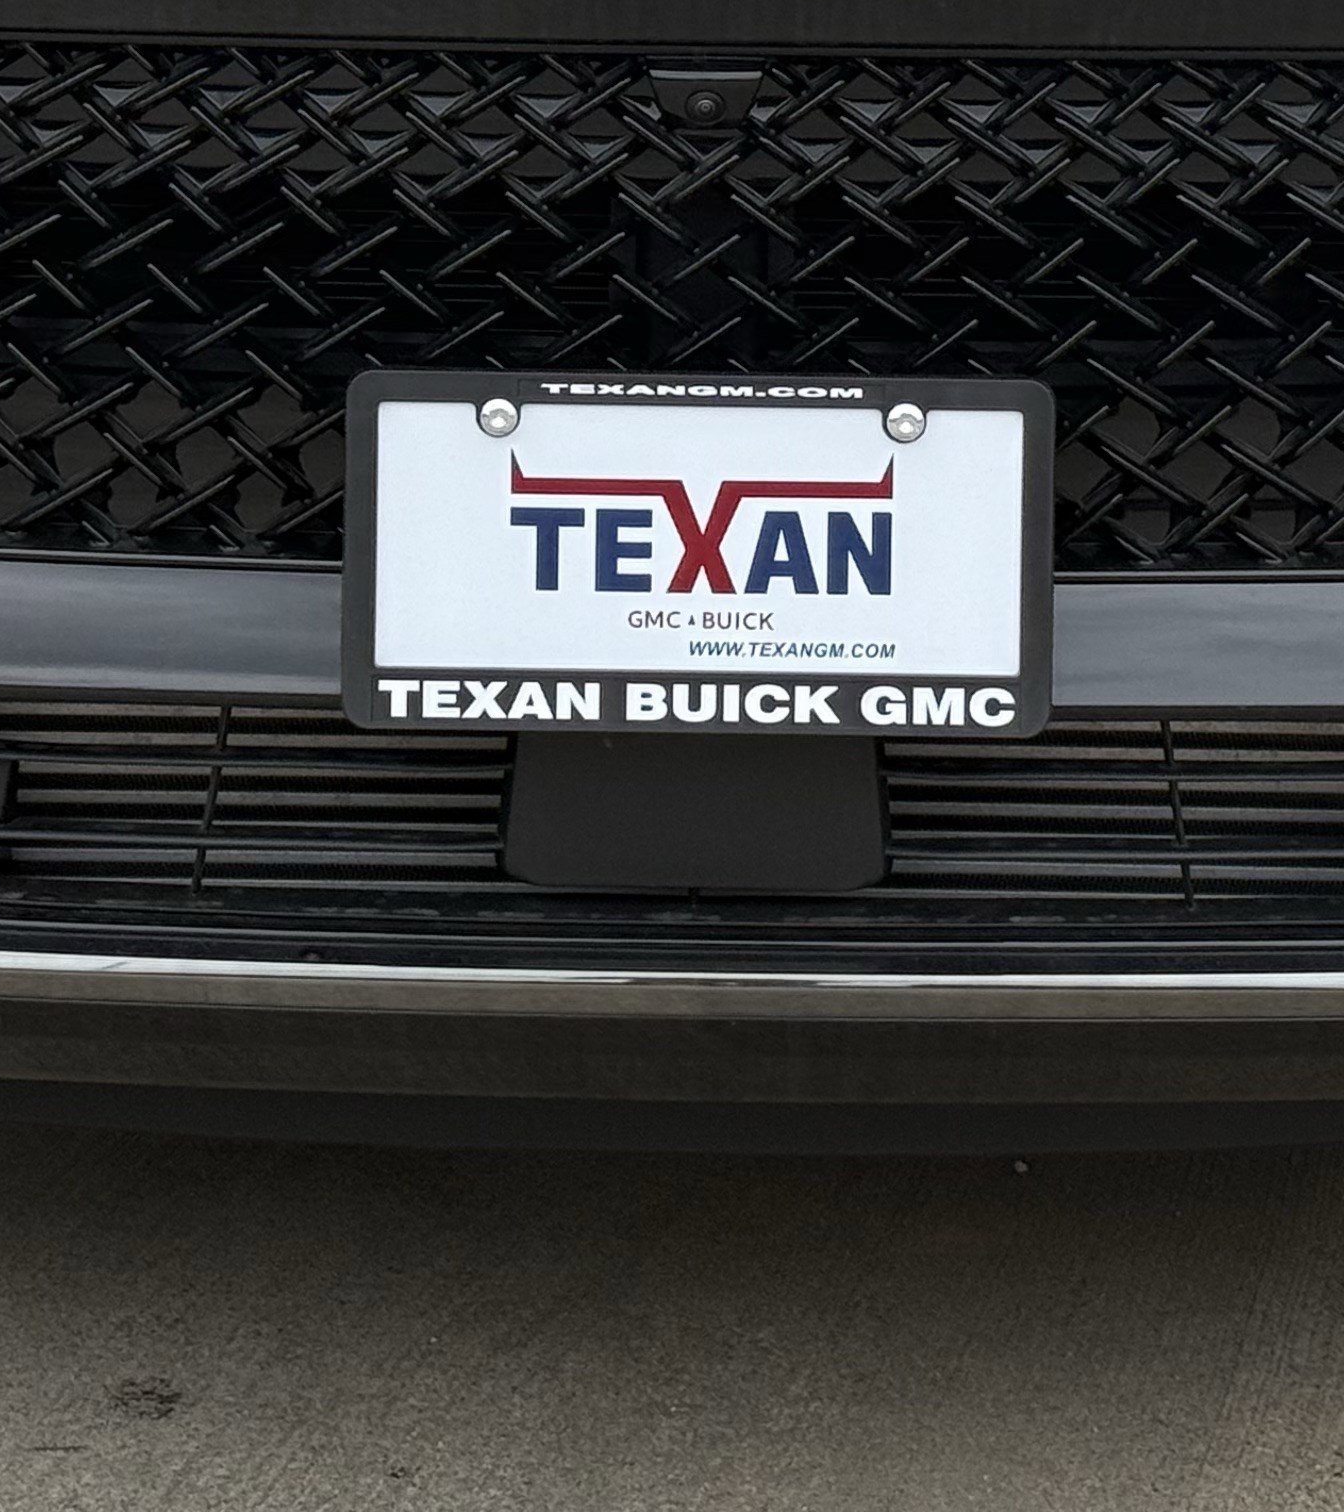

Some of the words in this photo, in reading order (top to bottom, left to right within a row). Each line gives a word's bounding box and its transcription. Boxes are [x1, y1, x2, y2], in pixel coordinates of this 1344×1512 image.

[540, 382, 864, 399] TEXANGM.COM
[510, 480, 894, 596] TEXAN
[627, 609, 681, 630] GMC
[702, 610, 774, 631] BUICK
[688, 639, 896, 660] WWW.TEXANGM.COM
[377, 679, 601, 721] TEXAN
[625, 682, 841, 725] BUICK
[860, 685, 1017, 728] GMC
